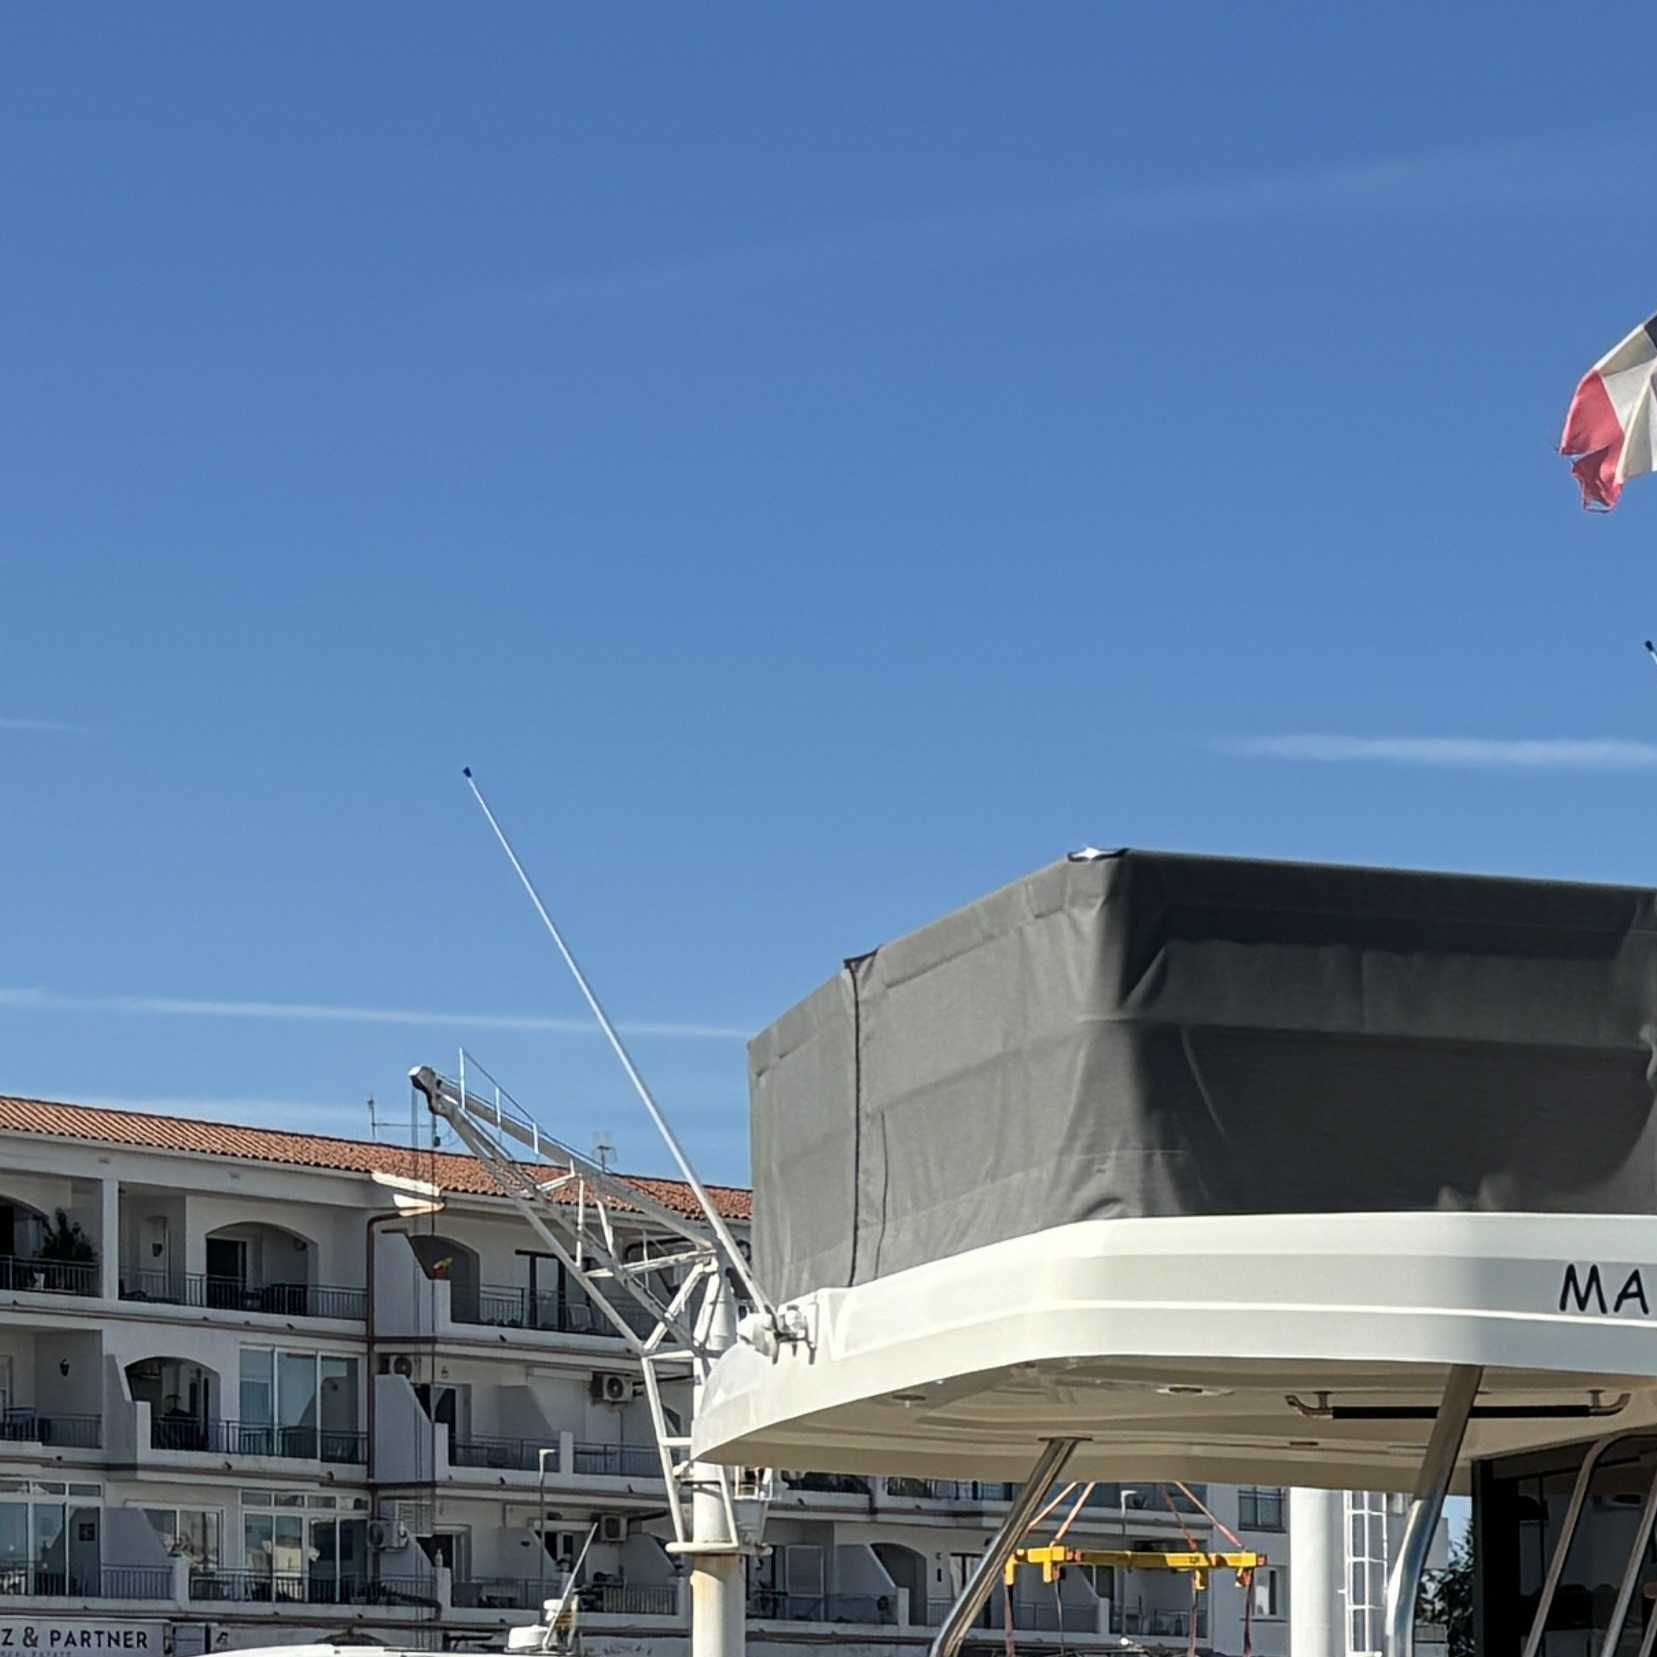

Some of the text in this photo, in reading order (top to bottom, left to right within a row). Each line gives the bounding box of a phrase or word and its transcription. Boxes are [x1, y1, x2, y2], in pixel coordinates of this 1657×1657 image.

[1558, 1263, 1649, 1317] MA
[22, 1626, 39, 1649] &
[50, 1629, 150, 1649] PARTNER
